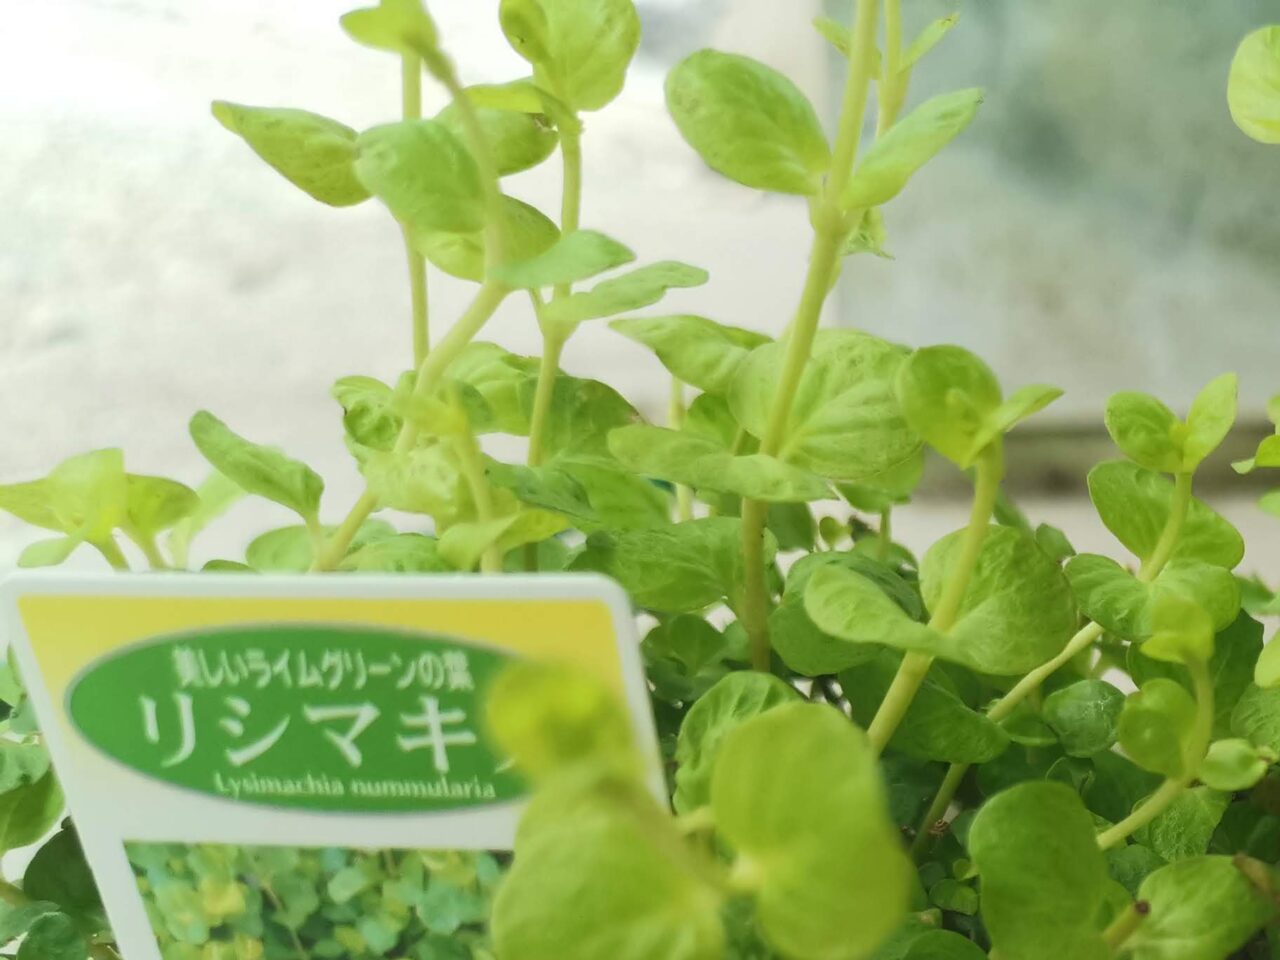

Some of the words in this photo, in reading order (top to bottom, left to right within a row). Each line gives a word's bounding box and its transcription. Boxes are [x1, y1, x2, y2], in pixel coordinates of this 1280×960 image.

[139, 692, 515, 774] リシマキ
[214, 771, 344, 799] Lysimachia
[350, 773, 496, 799] nummularia
